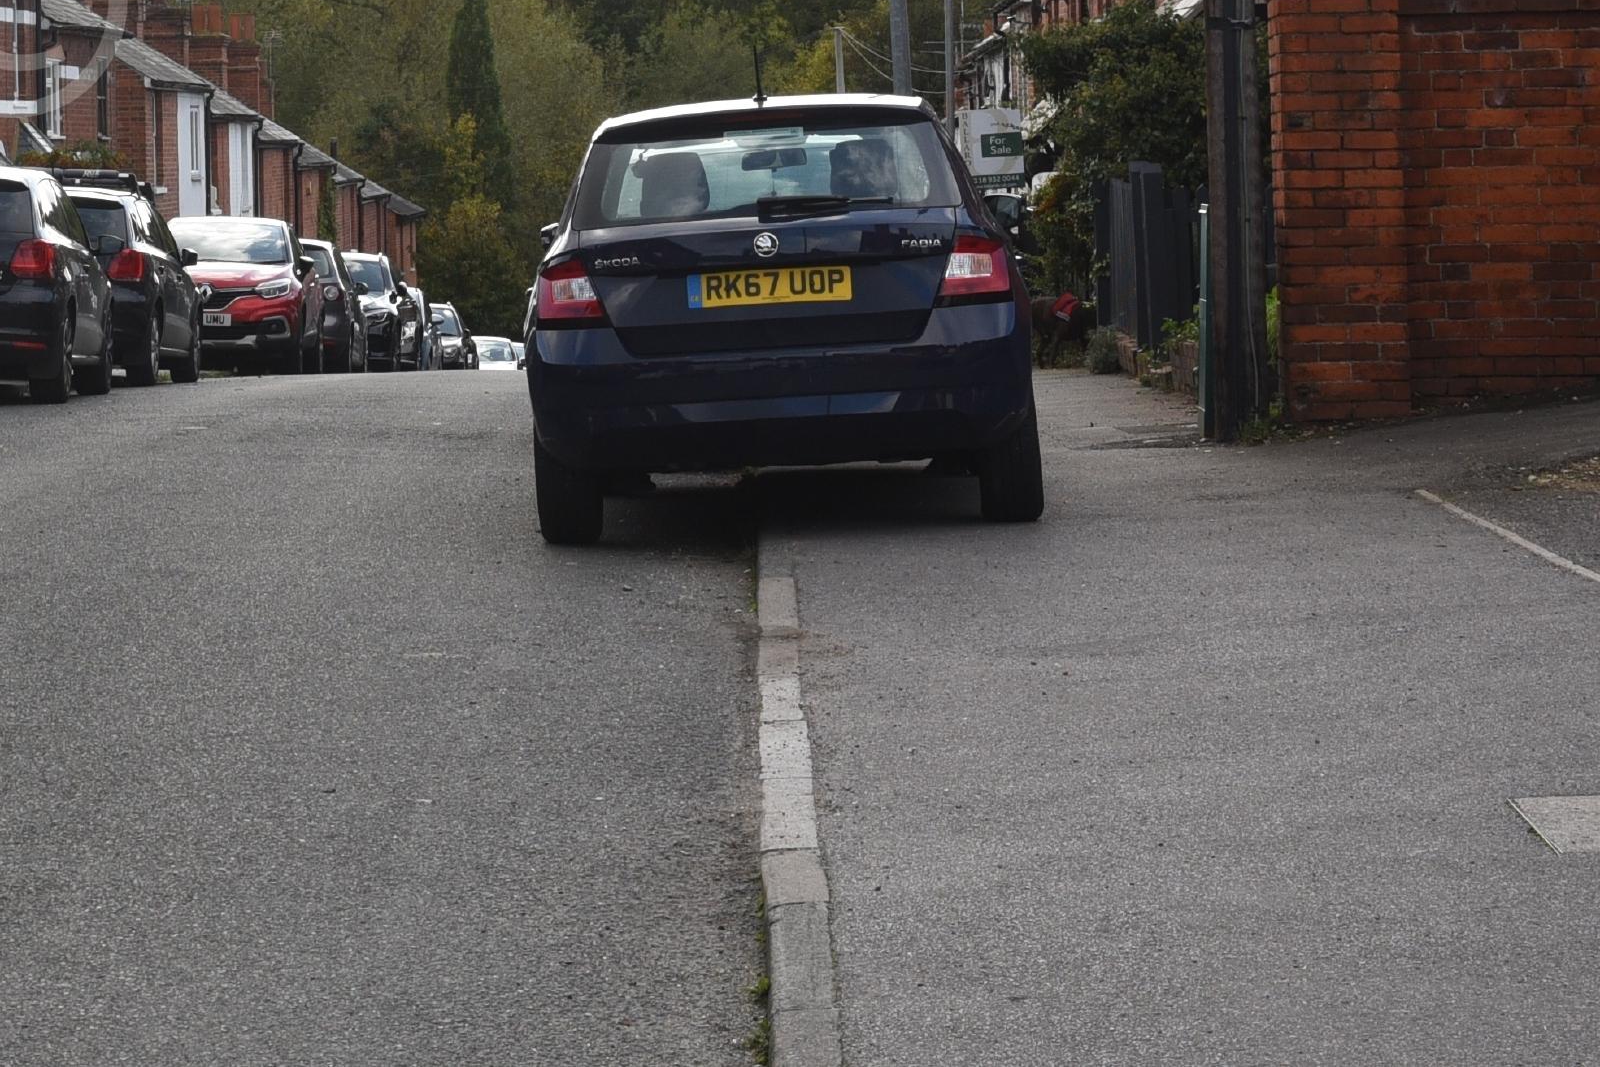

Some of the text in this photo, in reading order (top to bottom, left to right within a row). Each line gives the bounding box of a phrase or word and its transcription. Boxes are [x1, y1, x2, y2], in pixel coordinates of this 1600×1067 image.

[989, 135, 1007, 145] For
[990, 145, 1012, 155] Sale
[900, 238, 942, 248] FABIA
[706, 269, 845, 301] RK67 UOP
[205, 314, 225, 324] UMU
